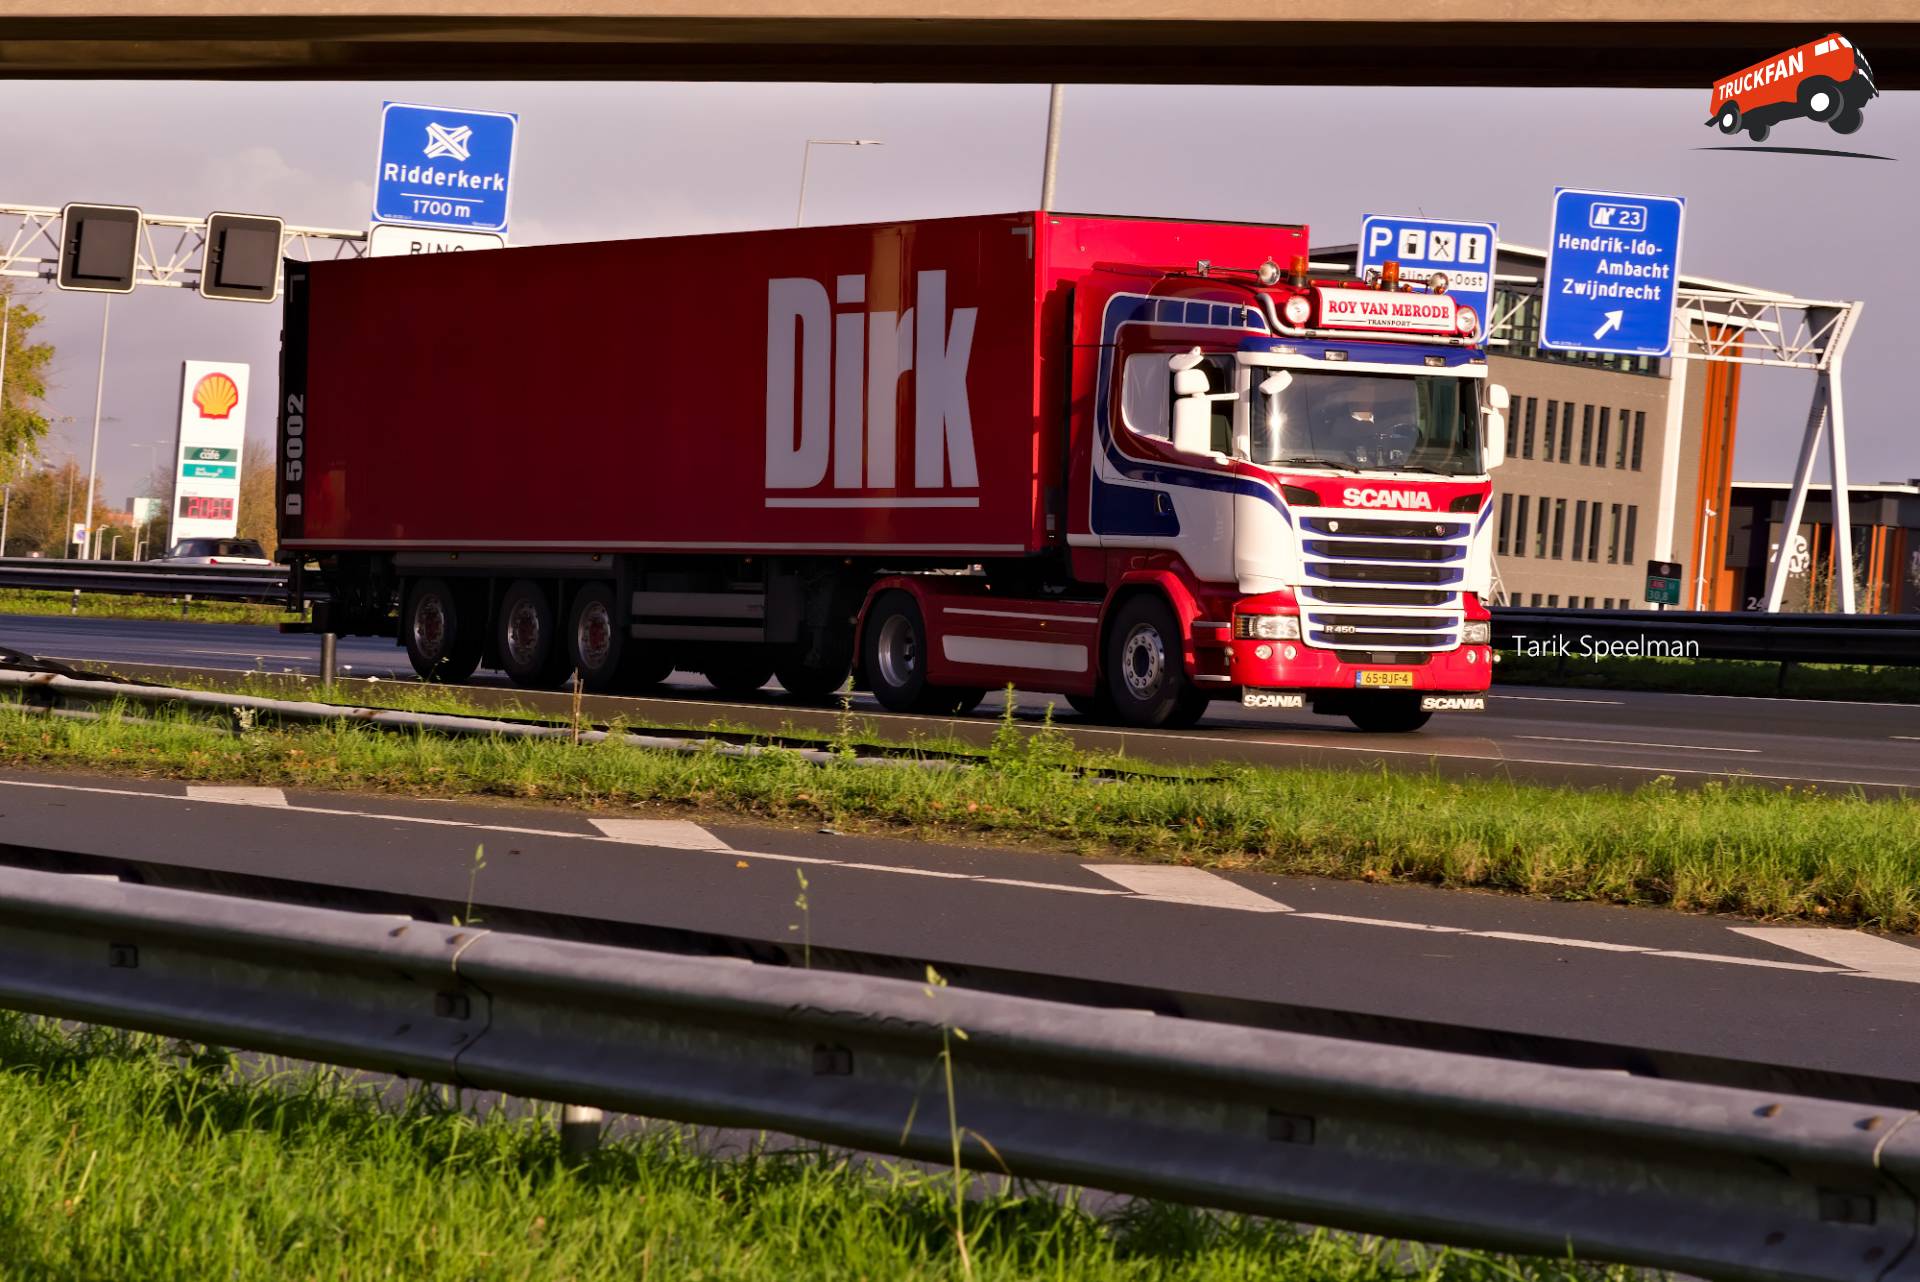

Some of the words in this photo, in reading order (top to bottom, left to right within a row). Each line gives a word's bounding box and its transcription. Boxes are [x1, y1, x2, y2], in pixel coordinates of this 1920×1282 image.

[384, 163, 504, 191] Ridderkerk
[413, 200, 451, 215] 1700
[455, 205, 470, 217] m
[1619, 211, 1640, 225] 23
[1558, 233, 1662, 255] Hendrik-Ido-
[1597, 259, 1669, 279] Ambacht
[1562, 278, 1661, 300] Zwijndrecht
[1329, 301, 1356, 314] ROY
[1361, 302, 1388, 316] VAN
[1392, 304, 1449, 319] MERODE
[1368, 319, 1411, 327] TRANSPORT
[765, 270, 980, 488] Dirk
[286, 394, 304, 481] 5002
[286, 494, 302, 515] D
[1343, 488, 1431, 509] SCANIA
[1326, 625, 1333, 633] R
[1334, 625, 1355, 634] 450
[1243, 695, 1303, 708] SCANIA
[1422, 697, 1485, 710] SCANIA
